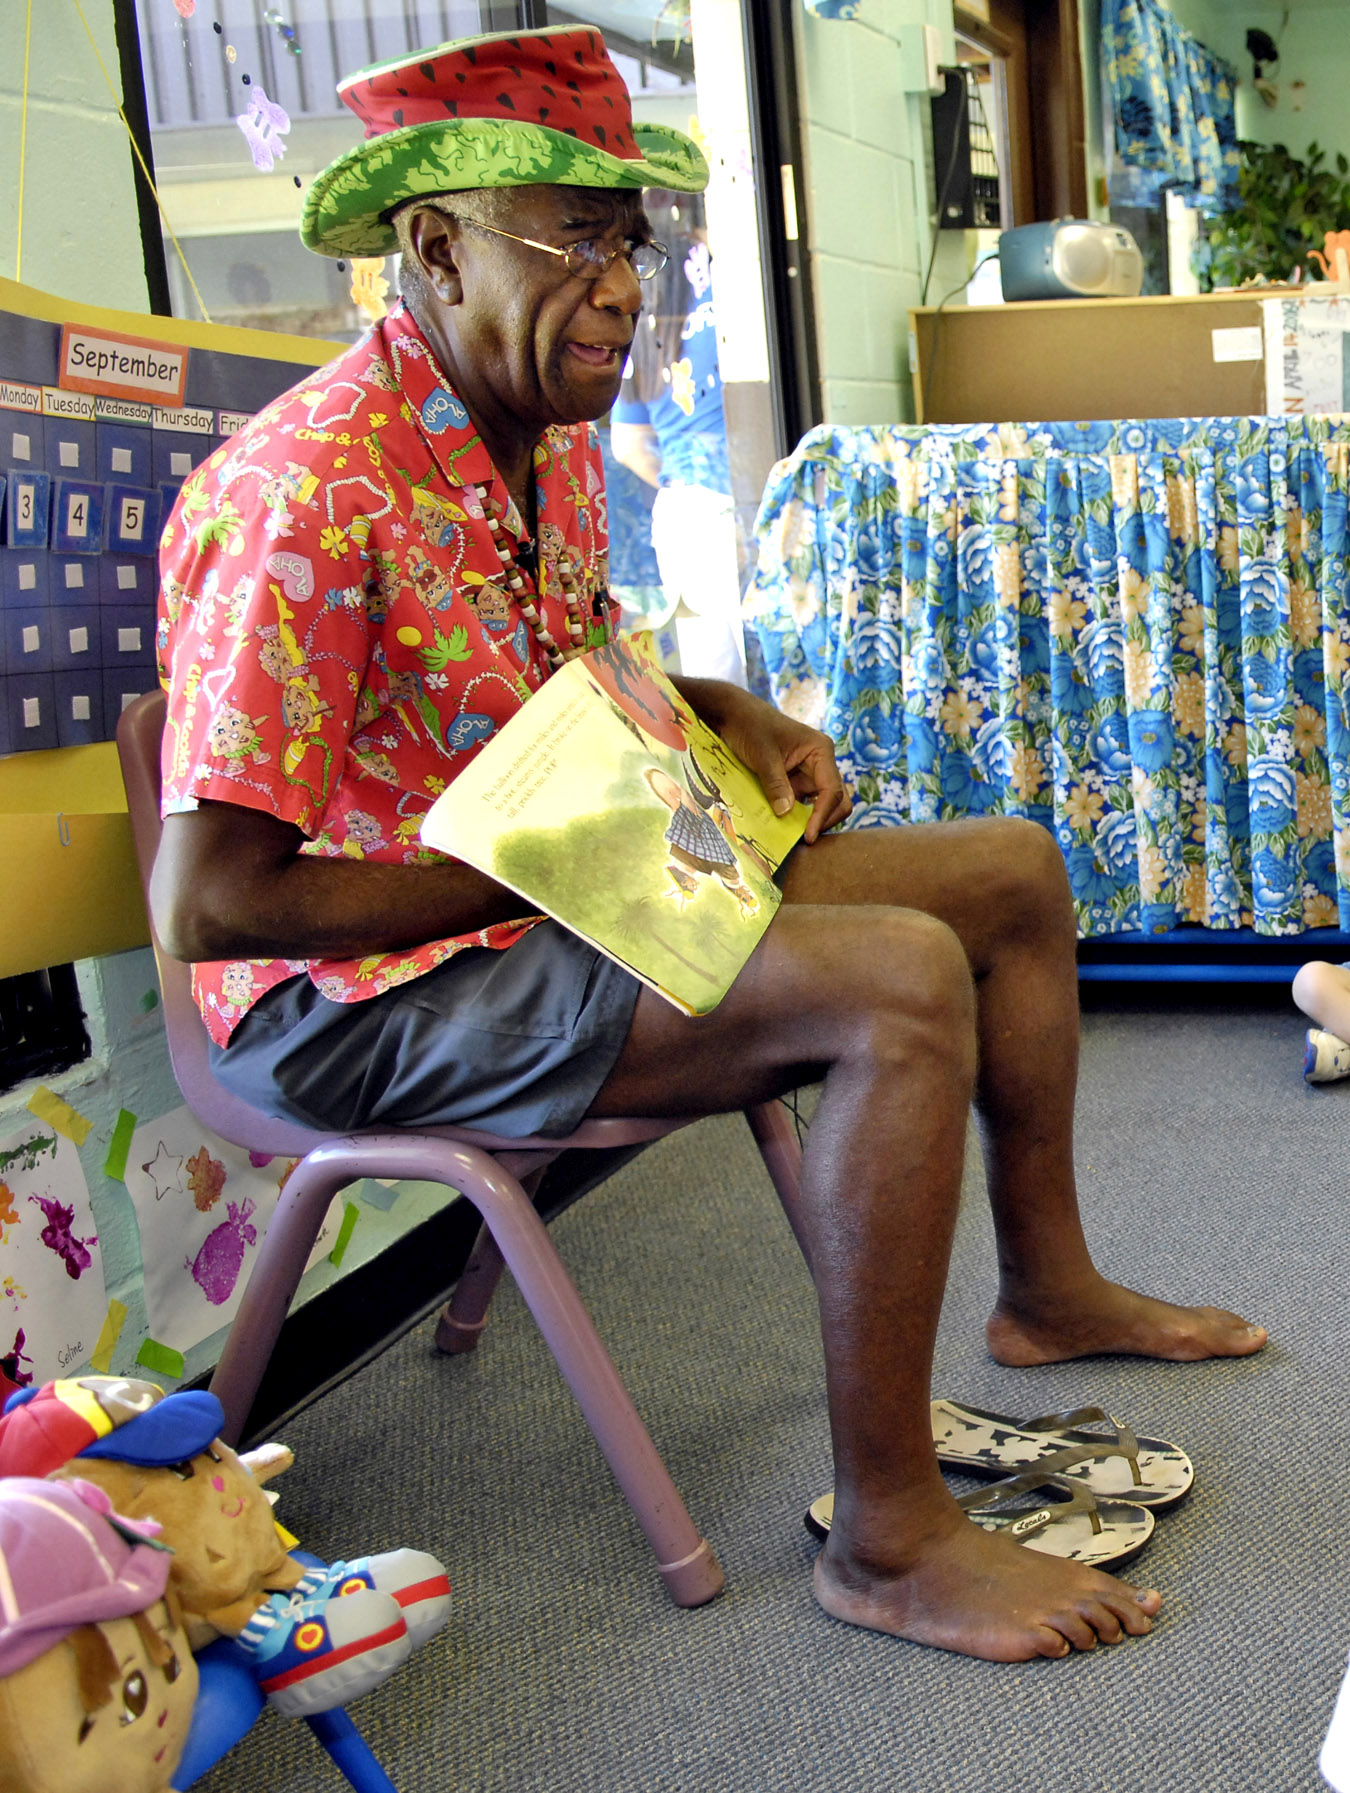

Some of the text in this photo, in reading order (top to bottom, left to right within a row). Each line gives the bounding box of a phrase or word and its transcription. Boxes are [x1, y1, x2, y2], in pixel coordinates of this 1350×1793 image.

[71, 342, 179, 383] September
[0, 384, 39, 411] Monday
[45, 393, 95, 421] Tuesday
[95, 400, 153, 422] Wednesday
[153, 408, 214, 432] Thursday
[295, 429, 335, 444] Chip
[21, 494, 139, 529] 3 4 5
[57, 1341, 84, 1368] Seline
[1016, 1513, 1047, 1531] Locals
